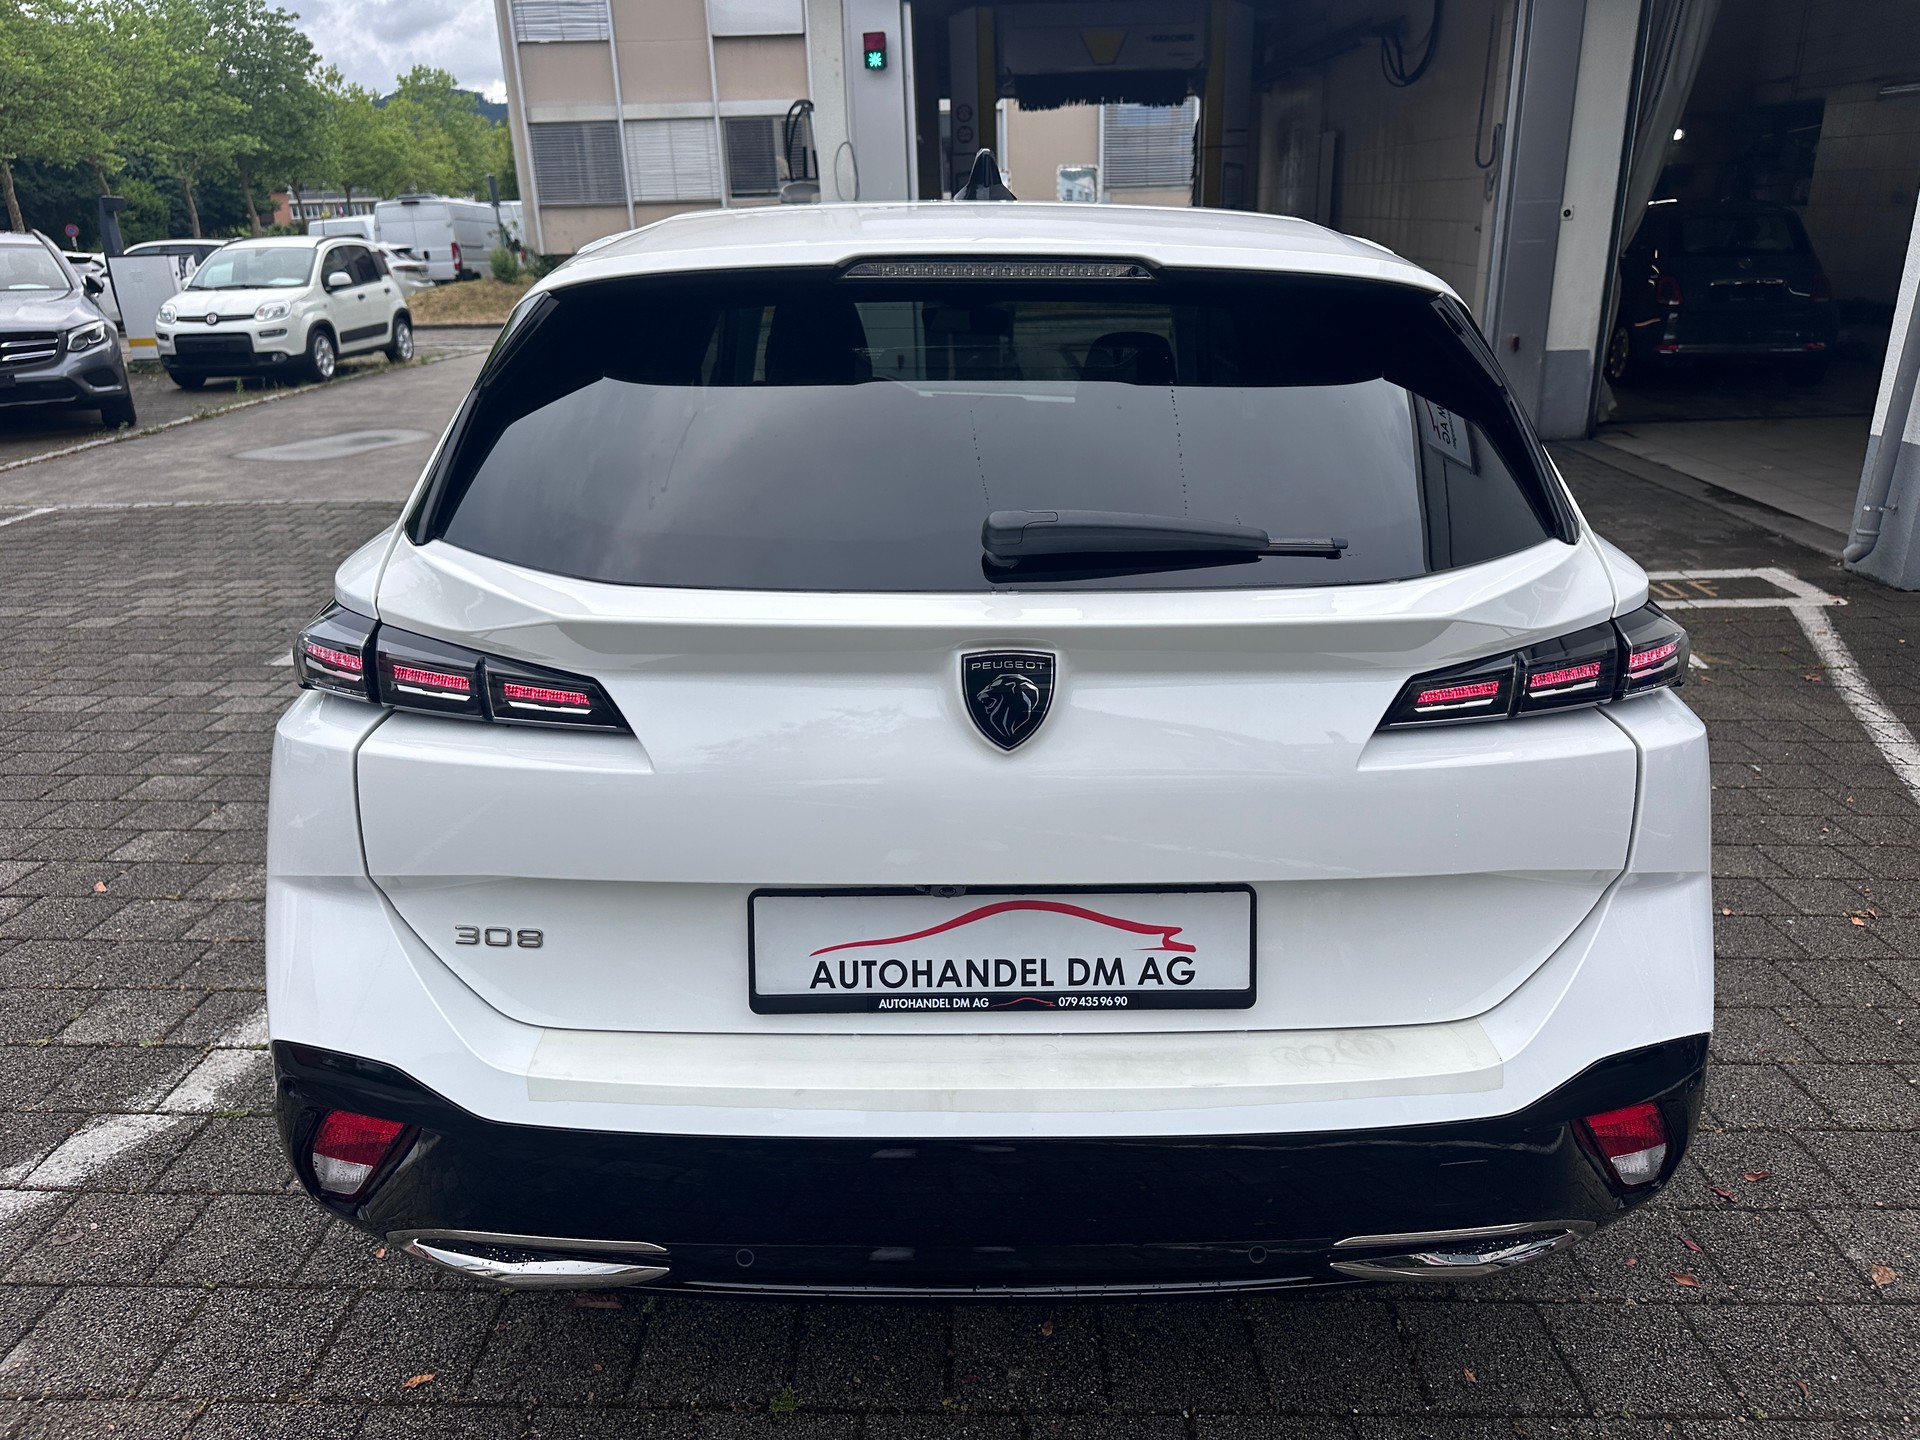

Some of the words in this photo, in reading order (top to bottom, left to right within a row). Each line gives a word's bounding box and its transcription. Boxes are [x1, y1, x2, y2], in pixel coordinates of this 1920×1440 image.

[971, 660, 1046, 671] PEUGEOT
[455, 925, 544, 949] 308
[809, 958, 1055, 989] AUTOHANDEL
[1067, 957, 1126, 986] DM
[1137, 956, 1196, 986] AG
[878, 998, 951, 1009] AUTOHANDEL
[952, 998, 971, 1008] DM
[972, 998, 990, 1008] AG
[1058, 997, 1078, 1006] 079
[1078, 997, 1099, 1006] 435
[1099, 996, 1114, 1006] 96
[1114, 996, 1128, 1006] 90
